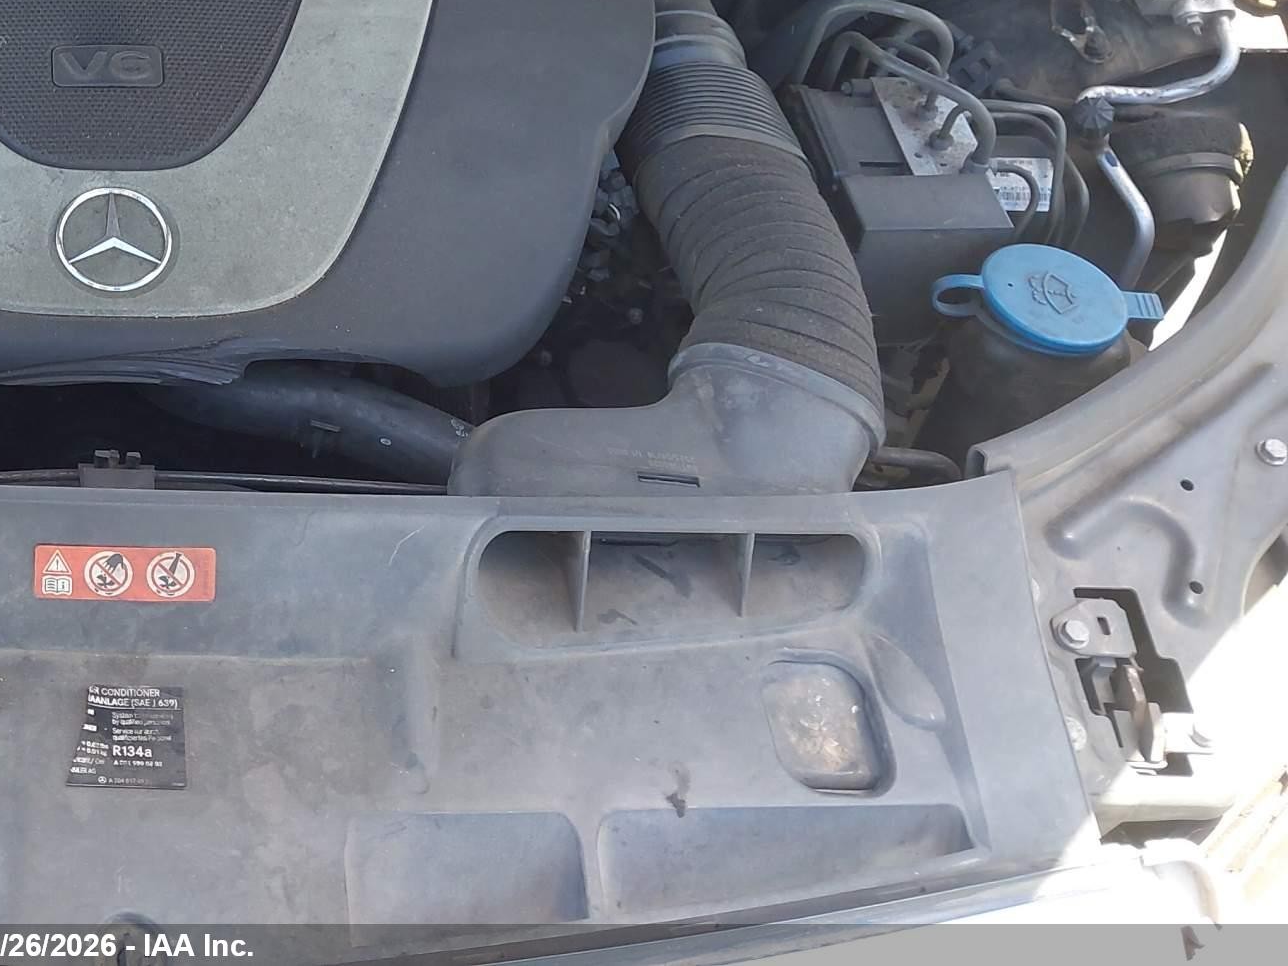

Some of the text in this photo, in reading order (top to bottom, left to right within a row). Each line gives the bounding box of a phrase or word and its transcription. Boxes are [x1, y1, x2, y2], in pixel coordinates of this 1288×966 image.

[58, 49, 153, 81] V6
[100, 687, 161, 698] CONDITIONER
[112, 744, 153, 758] R134a
